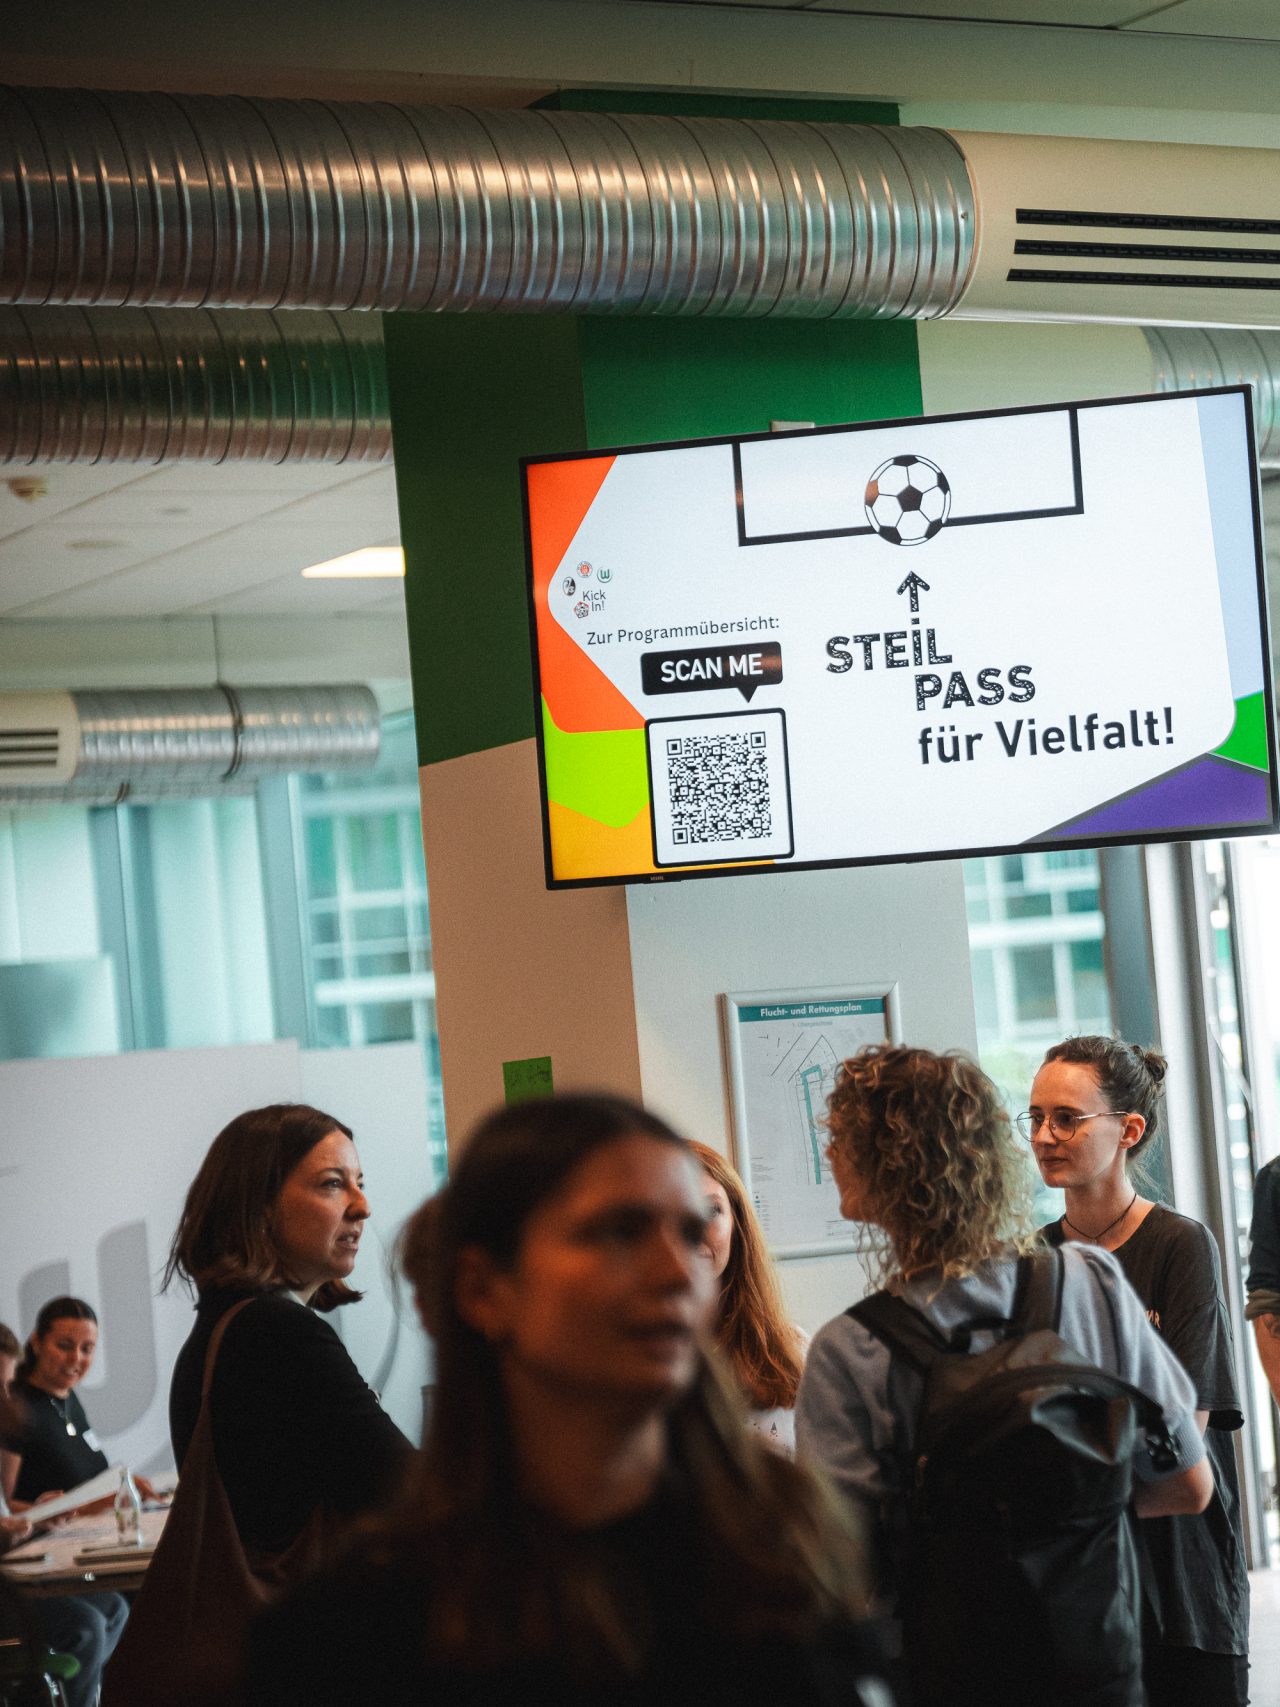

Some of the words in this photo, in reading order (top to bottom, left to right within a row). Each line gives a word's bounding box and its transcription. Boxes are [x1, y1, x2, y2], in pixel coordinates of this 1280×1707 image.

[582, 590, 607, 603] Kick
[591, 601, 605, 612] In!
[587, 630, 613, 645] Zur
[617, 616, 780, 643] Programmübersicht:
[661, 656, 723, 682] SCAN
[729, 653, 763, 677] ME
[915, 665, 1036, 711] PASS
[918, 725, 983, 764] für
[995, 706, 1175, 757] Vielfalt!
[760, 1008, 788, 1017] Flucht-
[791, 1006, 807, 1015] und
[808, 1004, 861, 1014] Rettungsplan
